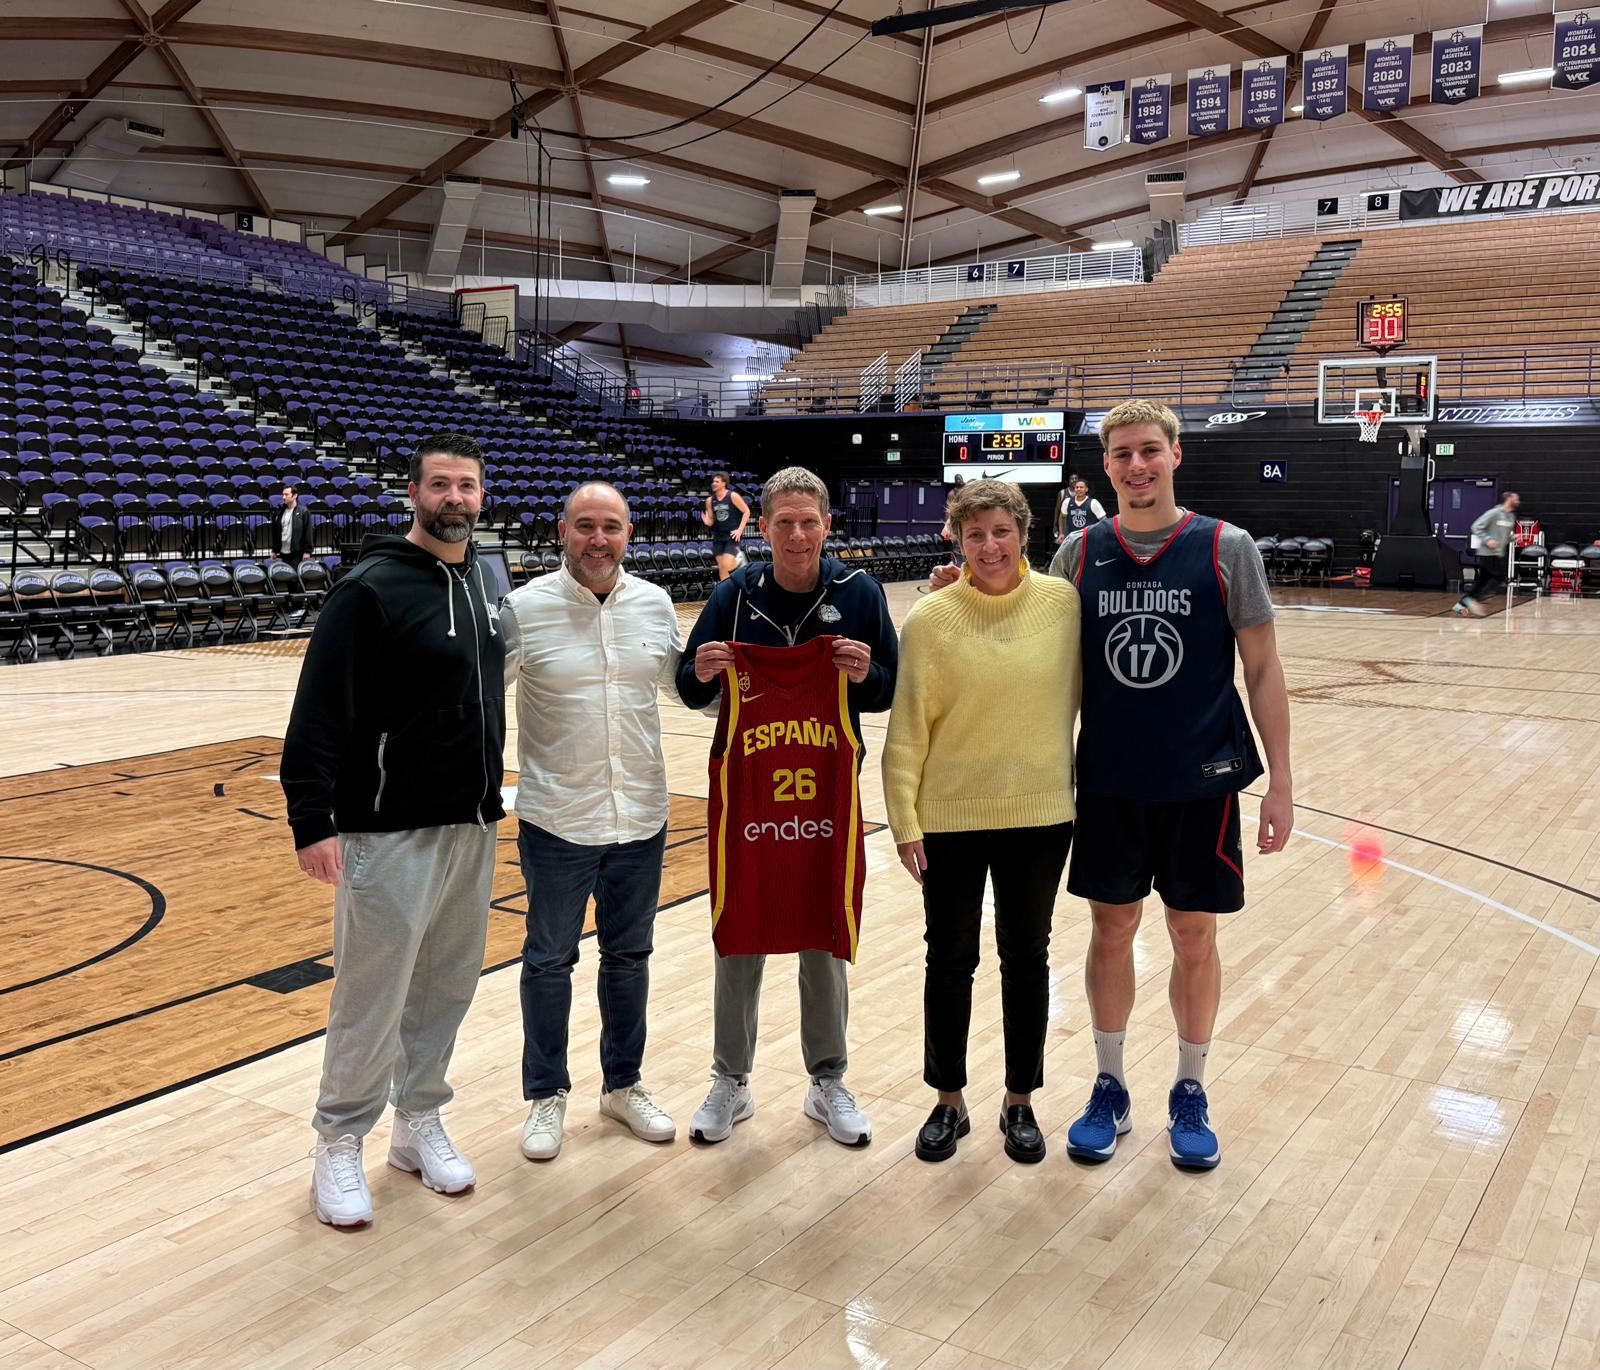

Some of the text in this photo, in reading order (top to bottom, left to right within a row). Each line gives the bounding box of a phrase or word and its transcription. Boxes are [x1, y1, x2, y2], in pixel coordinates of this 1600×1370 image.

[1564, 33, 1596, 43] BASKETBALL
[1567, 28, 1593, 37] WOMEN'S
[1445, 45, 1469, 54] WOMEN'S
[1562, 43, 1596, 58] 2024
[1442, 51, 1471, 60] BASKETBALL
[1440, 60, 1471, 75] 2023
[1564, 63, 1593, 71] CHAMPIONS
[1373, 69, 1402, 82] 2020
[1446, 73, 1476, 81] TOURNAMENT
[1566, 71, 1590, 81] WCC
[1312, 78, 1338, 92] 1997
[1250, 89, 1276, 101] 1996
[1444, 87, 1466, 97] WCC
[1196, 96, 1221, 109] 1994
[1377, 97, 1395, 105] WCC
[1138, 104, 1162, 118] 1992
[1316, 106, 1333, 114] WCC
[1254, 115, 1271, 123] WCC
[1200, 123, 1216, 131] WCC
[1141, 130, 1157, 138] WCC
[1437, 174, 1600, 213] WE ARE POR
[1324, 201, 1332, 212] 7
[1374, 196, 1382, 208] 8
[242, 217, 249, 228] 5
[972, 267, 979, 278] 6
[1012, 263, 1020, 274] 7
[1372, 303, 1402, 317] 2:55
[1369, 317, 1398, 340] 30
[948, 435, 968, 443] HOME
[992, 434, 1021, 448] 2:55
[1036, 432, 1060, 442] GUEST
[960, 446, 968, 460] 0
[1049, 445, 1058, 459] 0
[1263, 464, 1282, 478] 8A
[1126, 581, 1162, 589] GONZAGA
[1098, 588, 1192, 618] BULLDOGS
[1128, 644, 1157, 678] 17
[742, 717, 838, 757] ESPAÑA
[772, 767, 817, 801] 26
